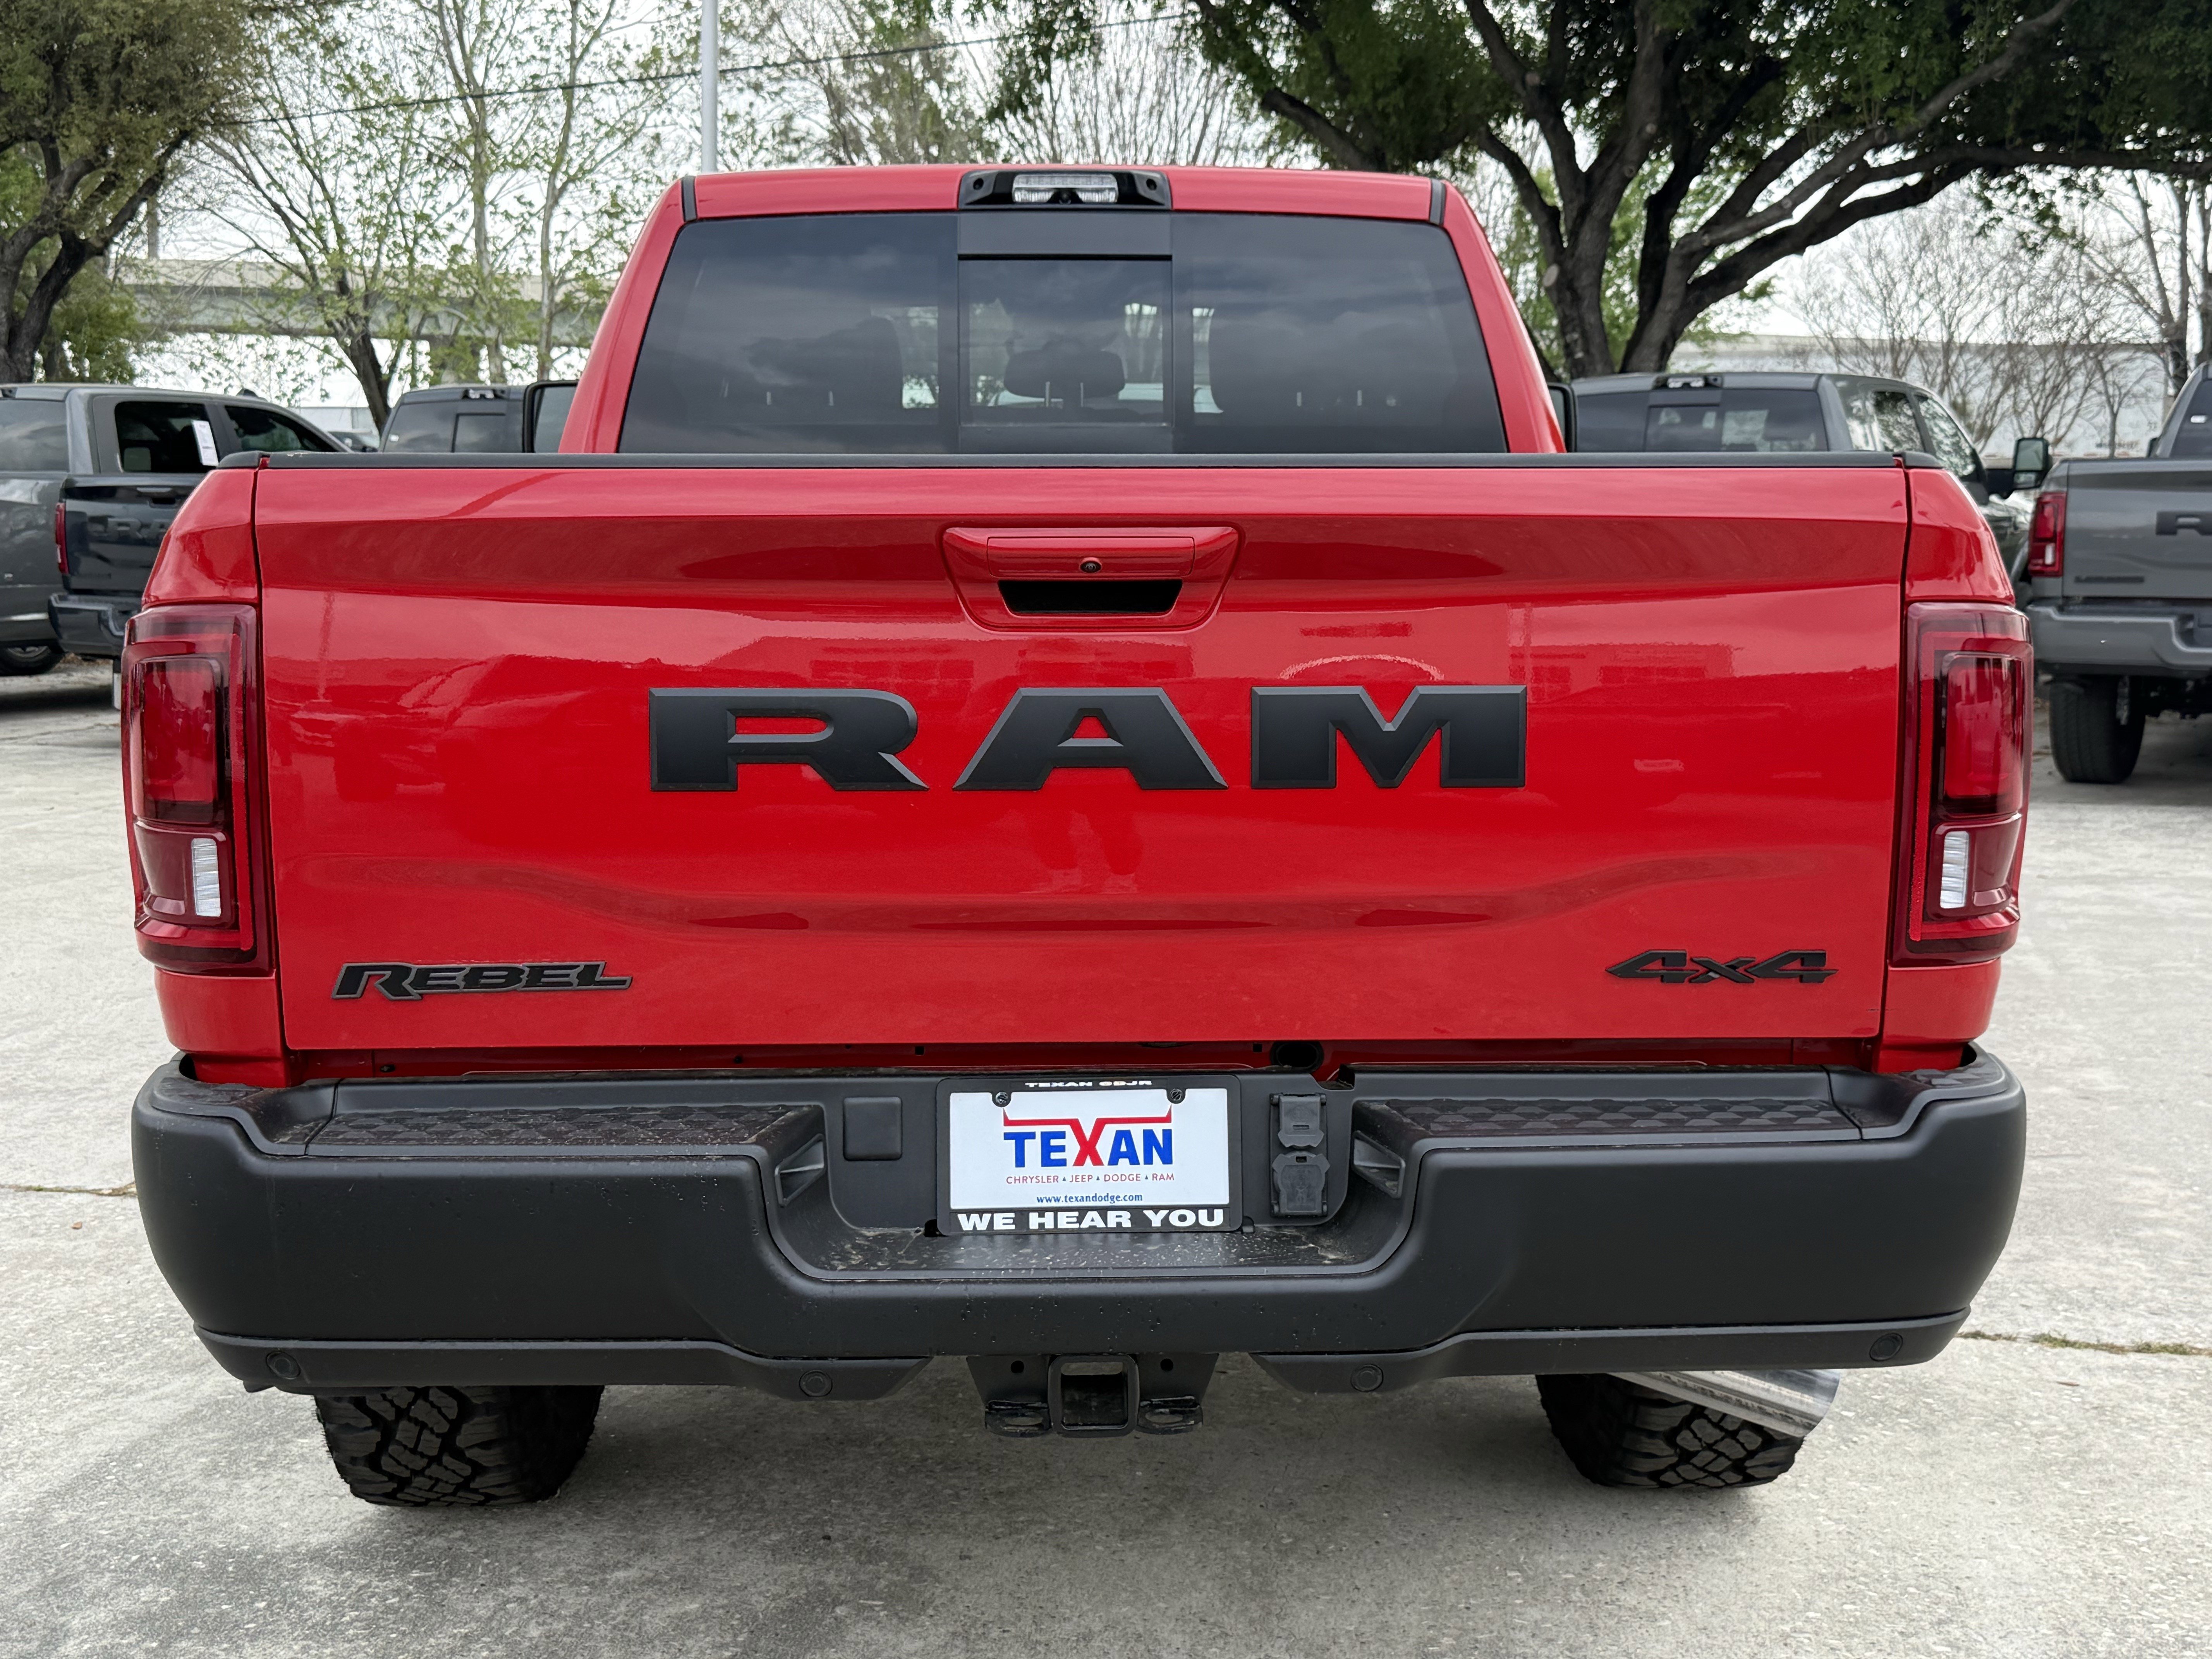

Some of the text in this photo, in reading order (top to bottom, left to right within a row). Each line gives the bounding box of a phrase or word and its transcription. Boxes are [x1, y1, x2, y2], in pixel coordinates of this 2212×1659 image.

[649, 685, 1527, 791] RAM
[331, 962, 633, 1000] REBEL
[1606, 950, 1839, 984] 4x4
[1003, 1117, 1173, 1168] TEXAN
[1006, 1173, 1175, 1184] CHRYSLER JEEP DODGE RAM
[1036, 1193, 1143, 1204] www.texandodge.com
[957, 1209, 1224, 1231] WE HEAR YOU
